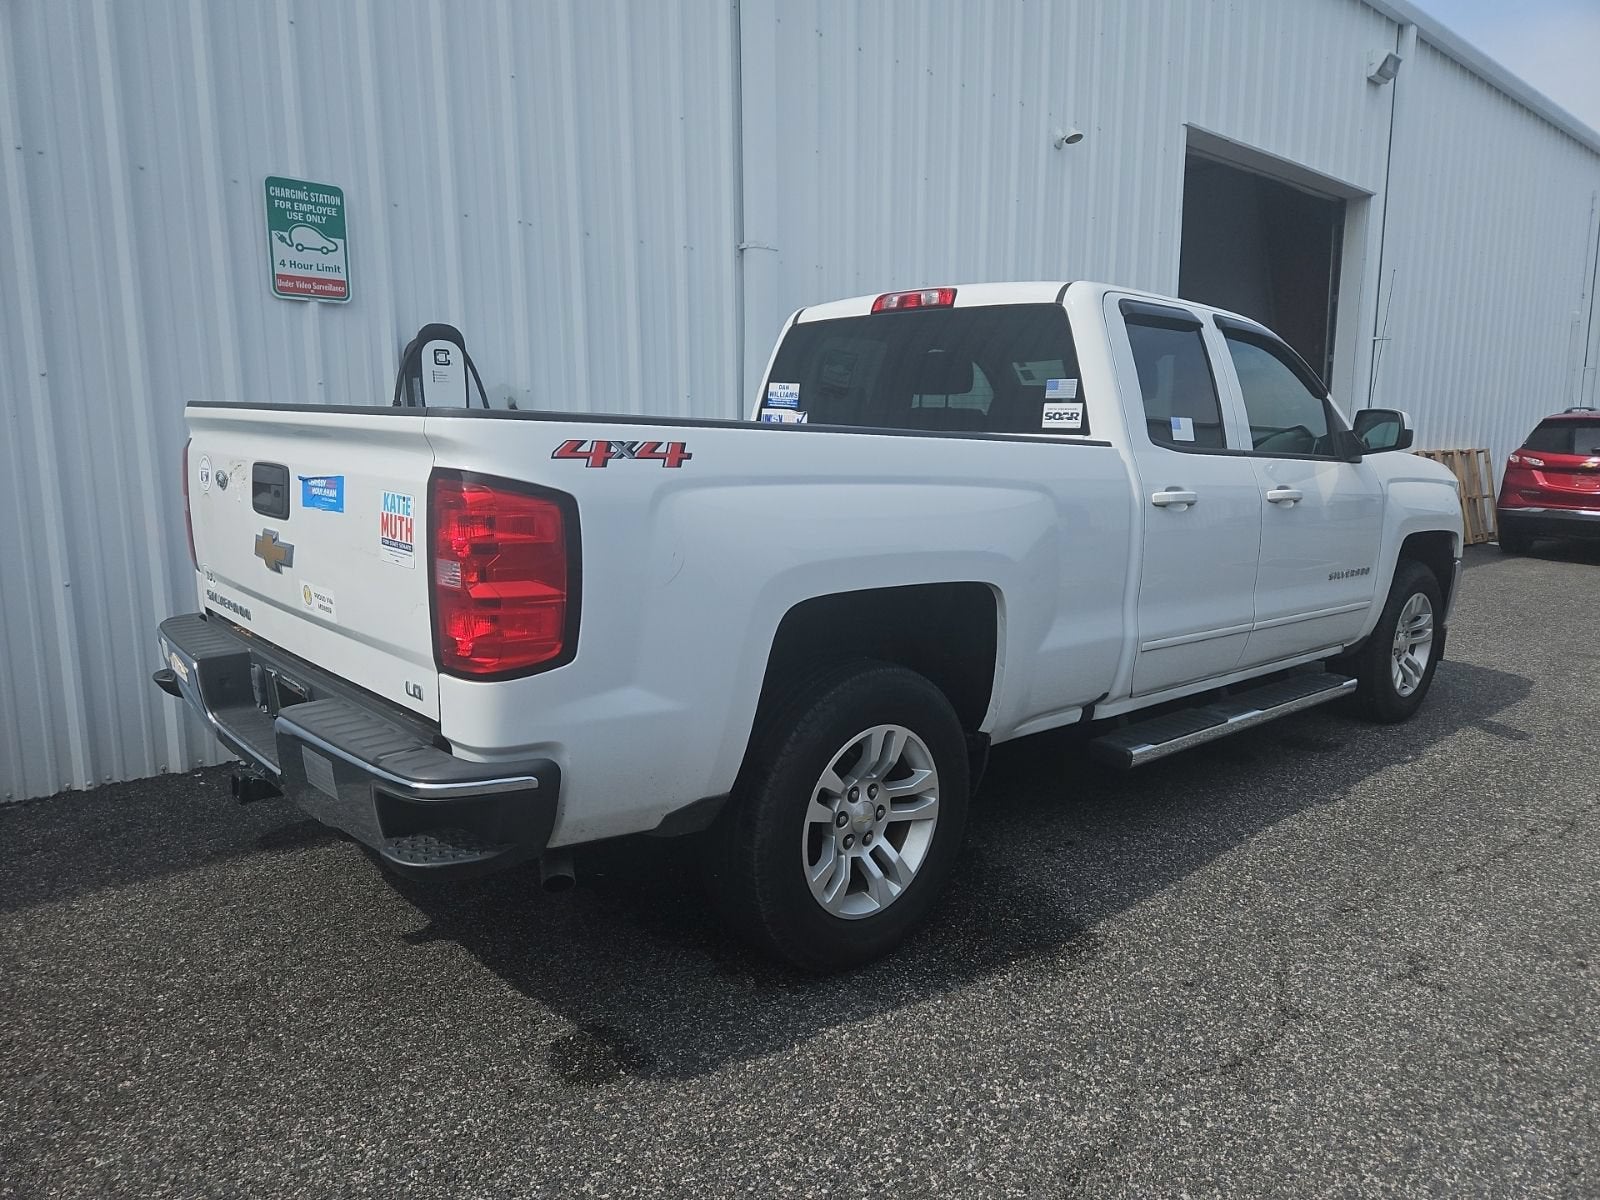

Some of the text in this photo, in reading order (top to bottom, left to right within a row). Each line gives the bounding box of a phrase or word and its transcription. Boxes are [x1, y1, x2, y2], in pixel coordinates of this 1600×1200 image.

[269, 186, 341, 206] CHARGING STATION
[274, 199, 337, 217] FOR EMPLOYEE
[286, 211, 327, 224] USE ONLY
[279, 259, 342, 274] 4 Hour Limit
[277, 278, 345, 293] Under Video Surveillance
[769, 391, 799, 399] WILLIAMS
[381, 511, 413, 544] MUTH
